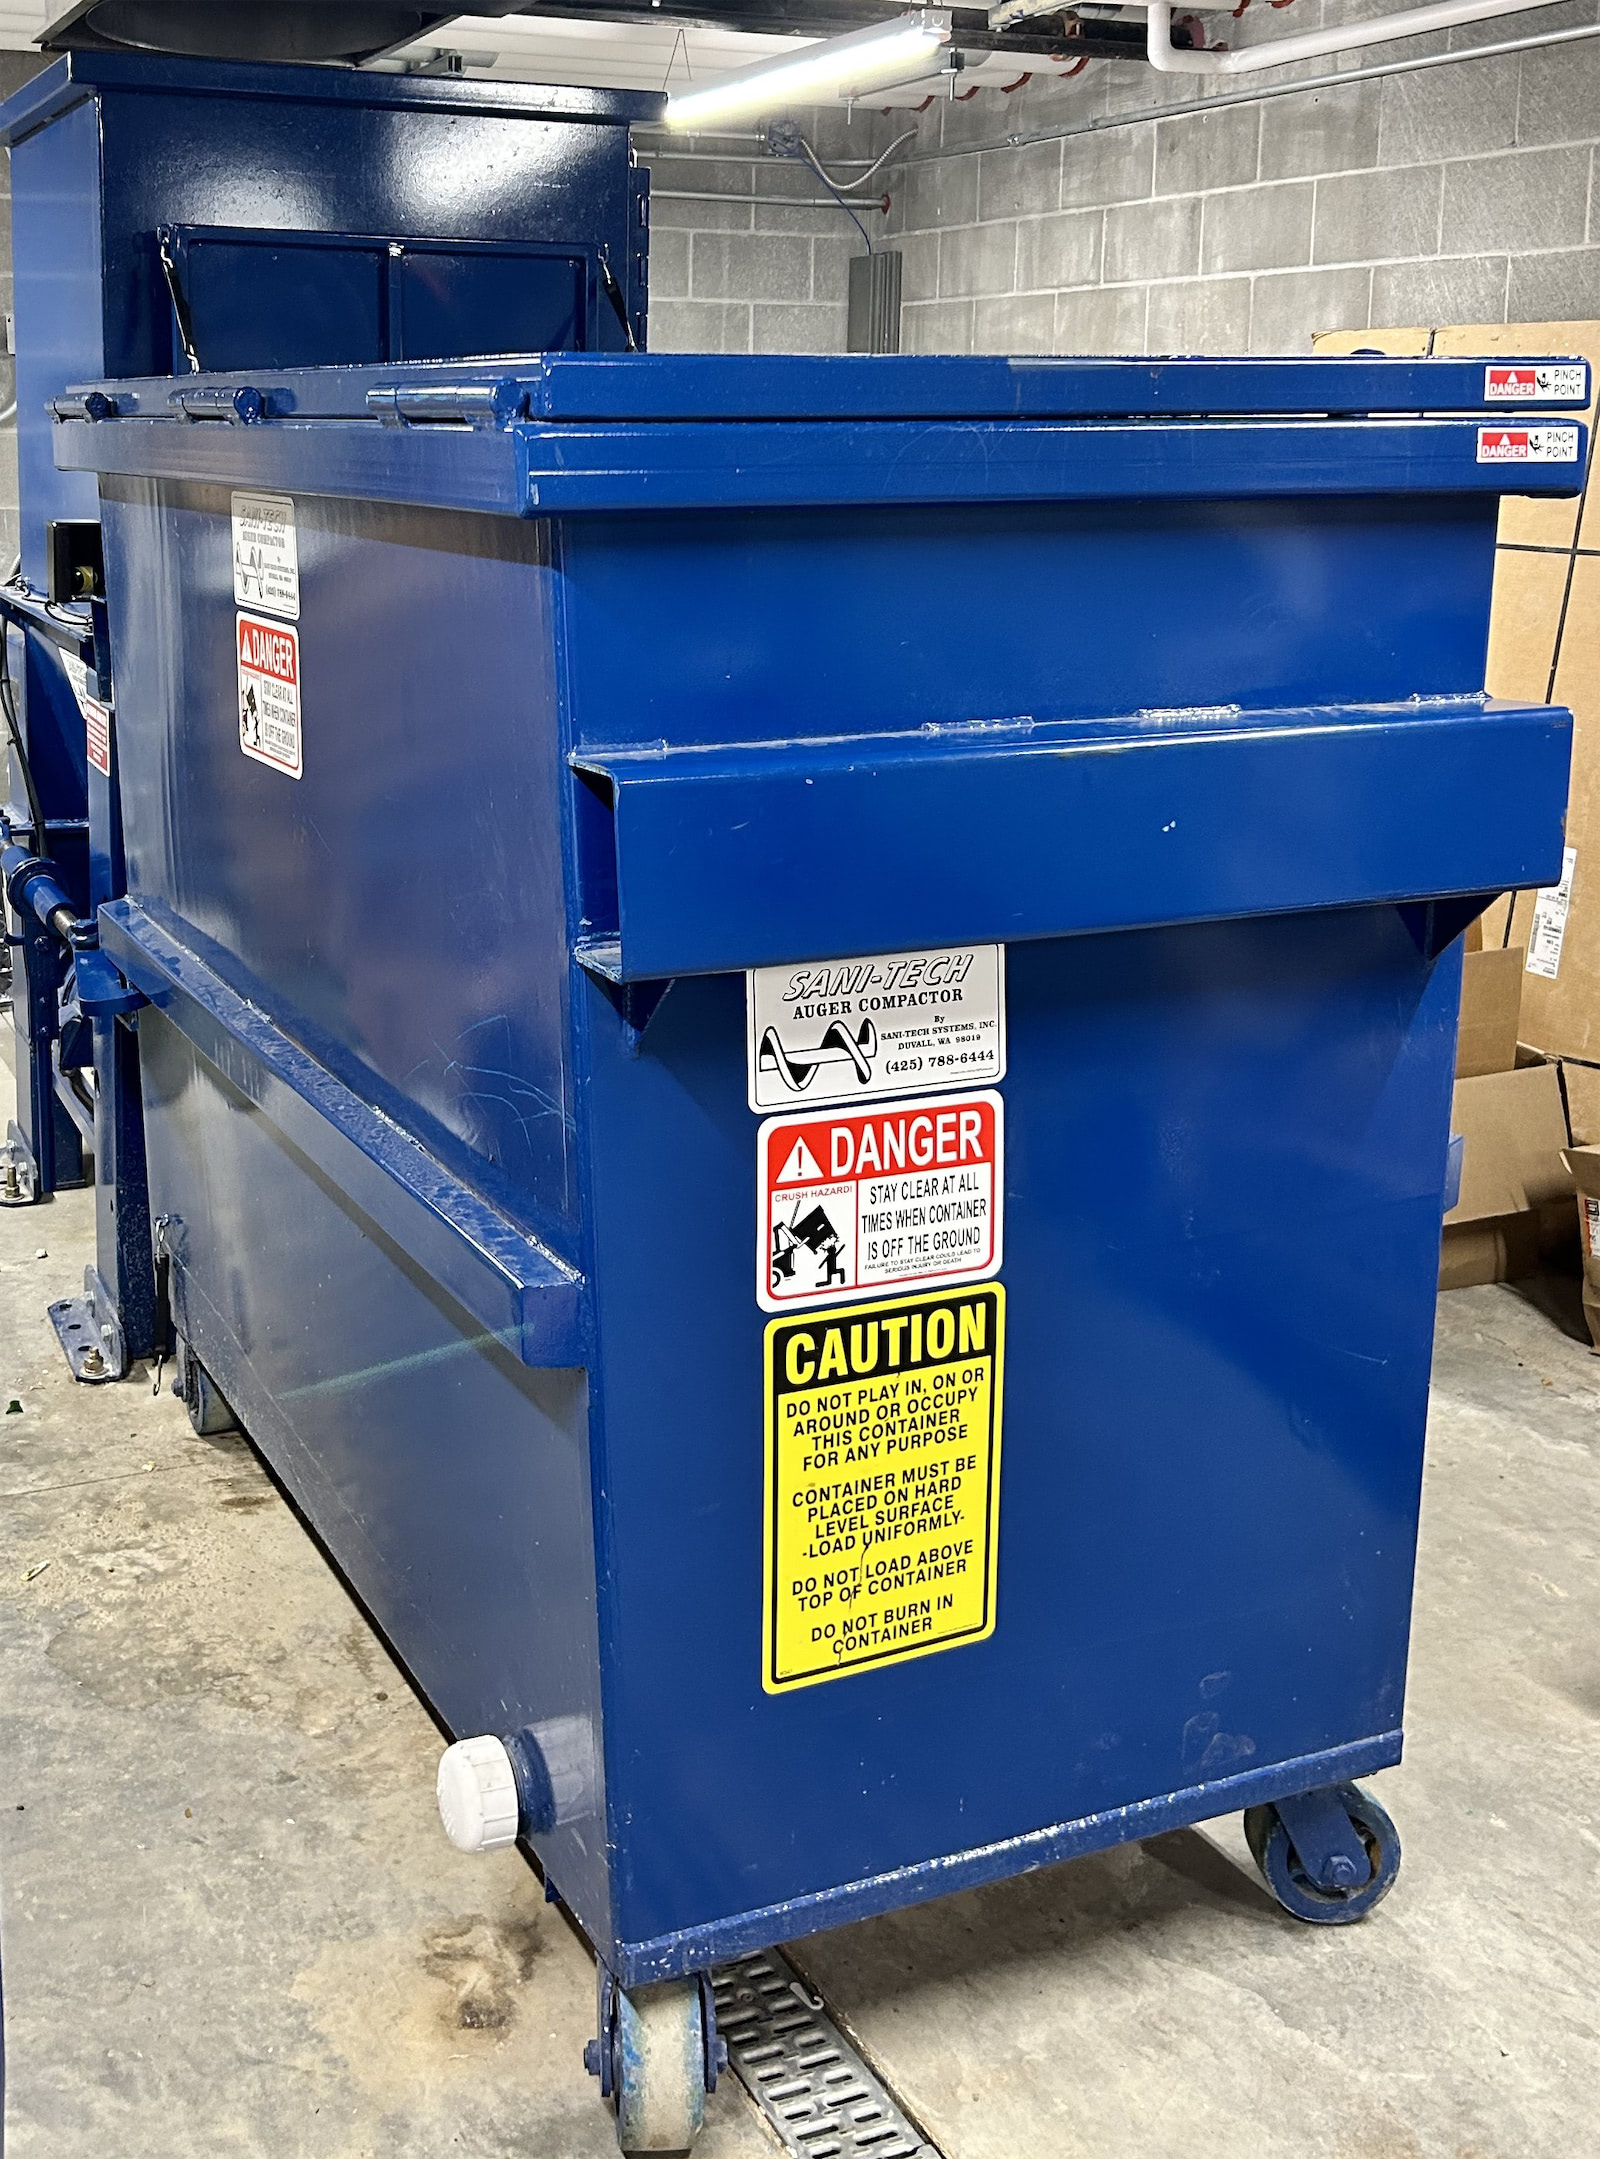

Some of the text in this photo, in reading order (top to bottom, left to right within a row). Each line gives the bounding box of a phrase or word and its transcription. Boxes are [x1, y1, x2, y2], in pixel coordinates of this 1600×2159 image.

[1489, 383, 1535, 395] DANGER
[1554, 369, 1581, 380] PINCH
[1554, 384, 1581, 395] POINT
[1482, 445, 1527, 457] DANGER
[1546, 446, 1573, 458] POINT
[1547, 432, 1574, 443] PINCH
[252, 628, 294, 679] DANGER
[782, 954, 974, 1001] SANI-TECH
[793, 989, 963, 1019] AUGER COMPACTOR
[934, 1015, 945, 1023] By
[880, 1020, 997, 1040] SANI-TECH SYSTEMS, INC.
[898, 1040, 935, 1050] DUVALL,
[886, 1050, 994, 1074] (425) 788-6444
[830, 1110, 983, 1177] DANGER
[775, 1191, 808, 1202] CRUSH
[870, 1172, 979, 1205] STAY CLEAR AT ALL
[861, 1198, 987, 1234] TIMES WHEN CONTAINER
[867, 1226, 980, 1261] IS OFF THE GROUND
[785, 1302, 986, 1385] CAUTION
[786, 1367, 985, 1418] DO NOT PLAY IN, ON OR
[793, 1386, 978, 1437] AROUND OR OCCUPY
[812, 1409, 960, 1451] THIS CONTAINER
[803, 1424, 968, 1472] FOR ANY PURPOSE
[792, 1455, 977, 1508] CONTAINER MUST BE
[807, 1476, 962, 1523] PLACED ON HARD
[802, 1509, 965, 1558] -LOAD UNIFORMLY-
[815, 1495, 954, 1539] LEVEL SURFACE
[792, 1539, 973, 1596] DO NOT LOAD ABOVE
[798, 1559, 967, 1612] TOP OF CONTAINER
[811, 1594, 953, 1642] DO NOT BURN IN
[832, 1617, 932, 1654] CONTAINER
